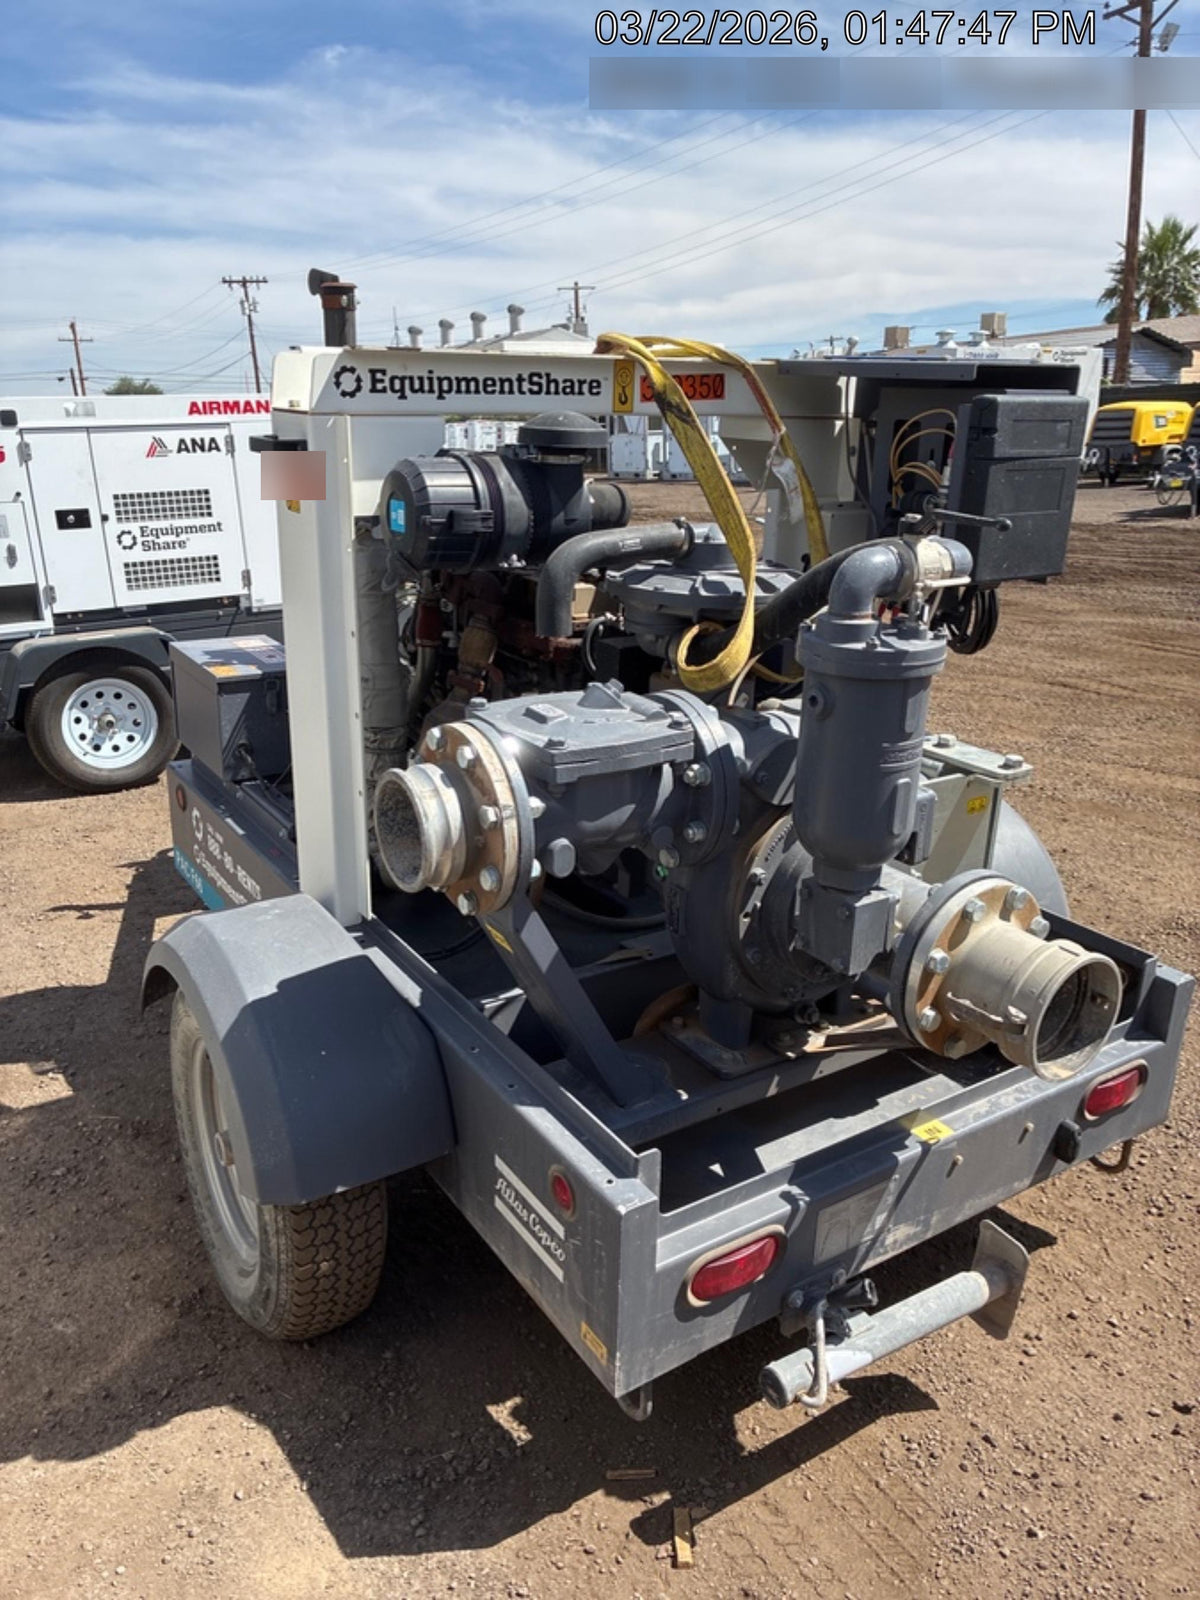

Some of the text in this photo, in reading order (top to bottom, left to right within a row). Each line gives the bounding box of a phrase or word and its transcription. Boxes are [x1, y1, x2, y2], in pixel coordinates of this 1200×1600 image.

[368, 368, 602, 400] EquipmentShare
[641, 373, 726, 401] 3350
[188, 399, 271, 416] AIRMAN
[176, 437, 221, 453] ANA
[139, 521, 223, 539] Equipment
[141, 539, 188, 552] Share
[495, 1178, 566, 1262] Atlas Copco
